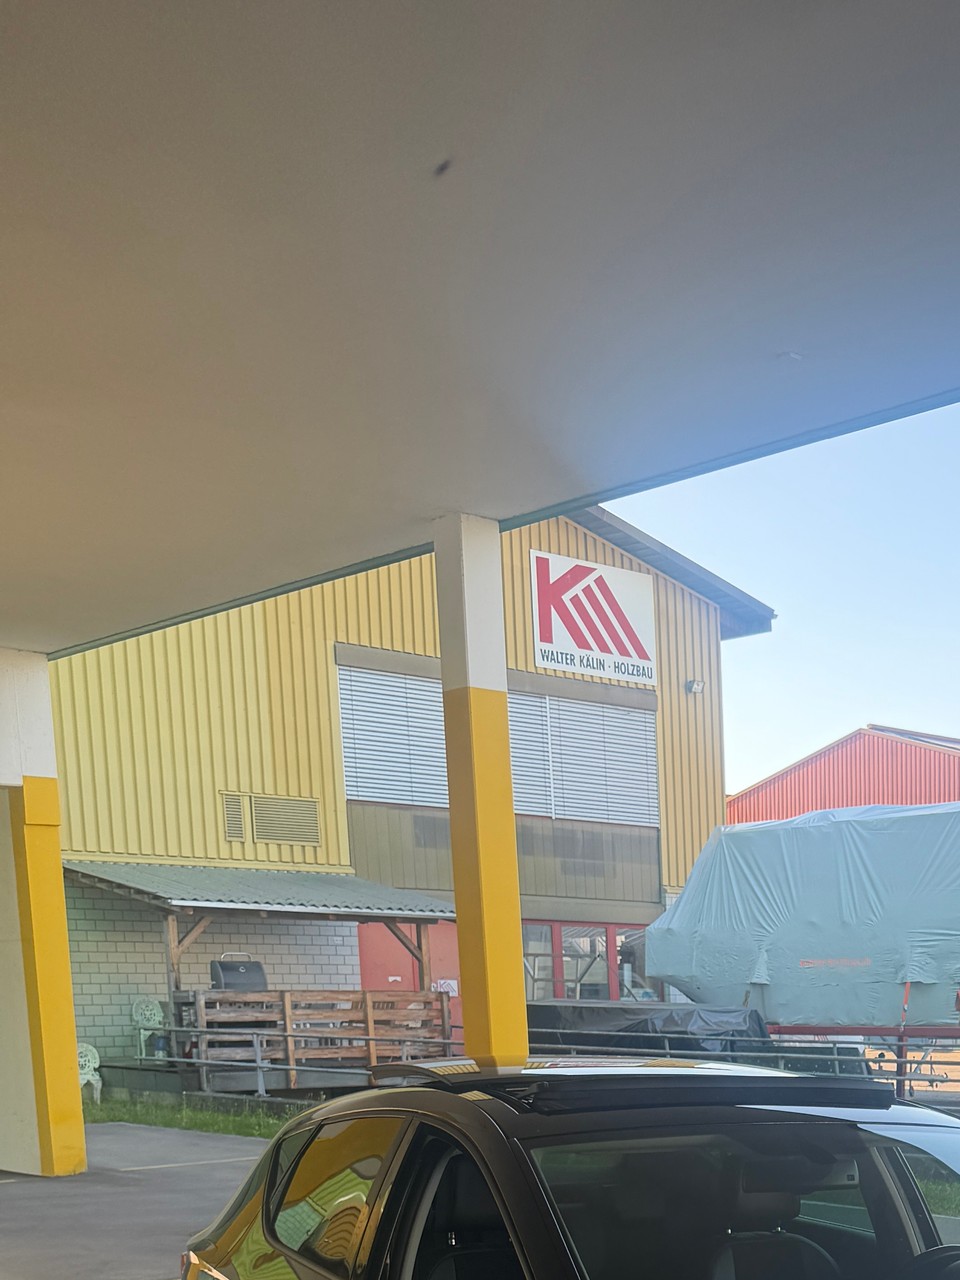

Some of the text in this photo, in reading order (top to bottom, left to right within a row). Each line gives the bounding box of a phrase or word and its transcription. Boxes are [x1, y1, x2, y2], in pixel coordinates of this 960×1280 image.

[540, 648, 653, 679] WALTER KÄLIN HOLZBAU
